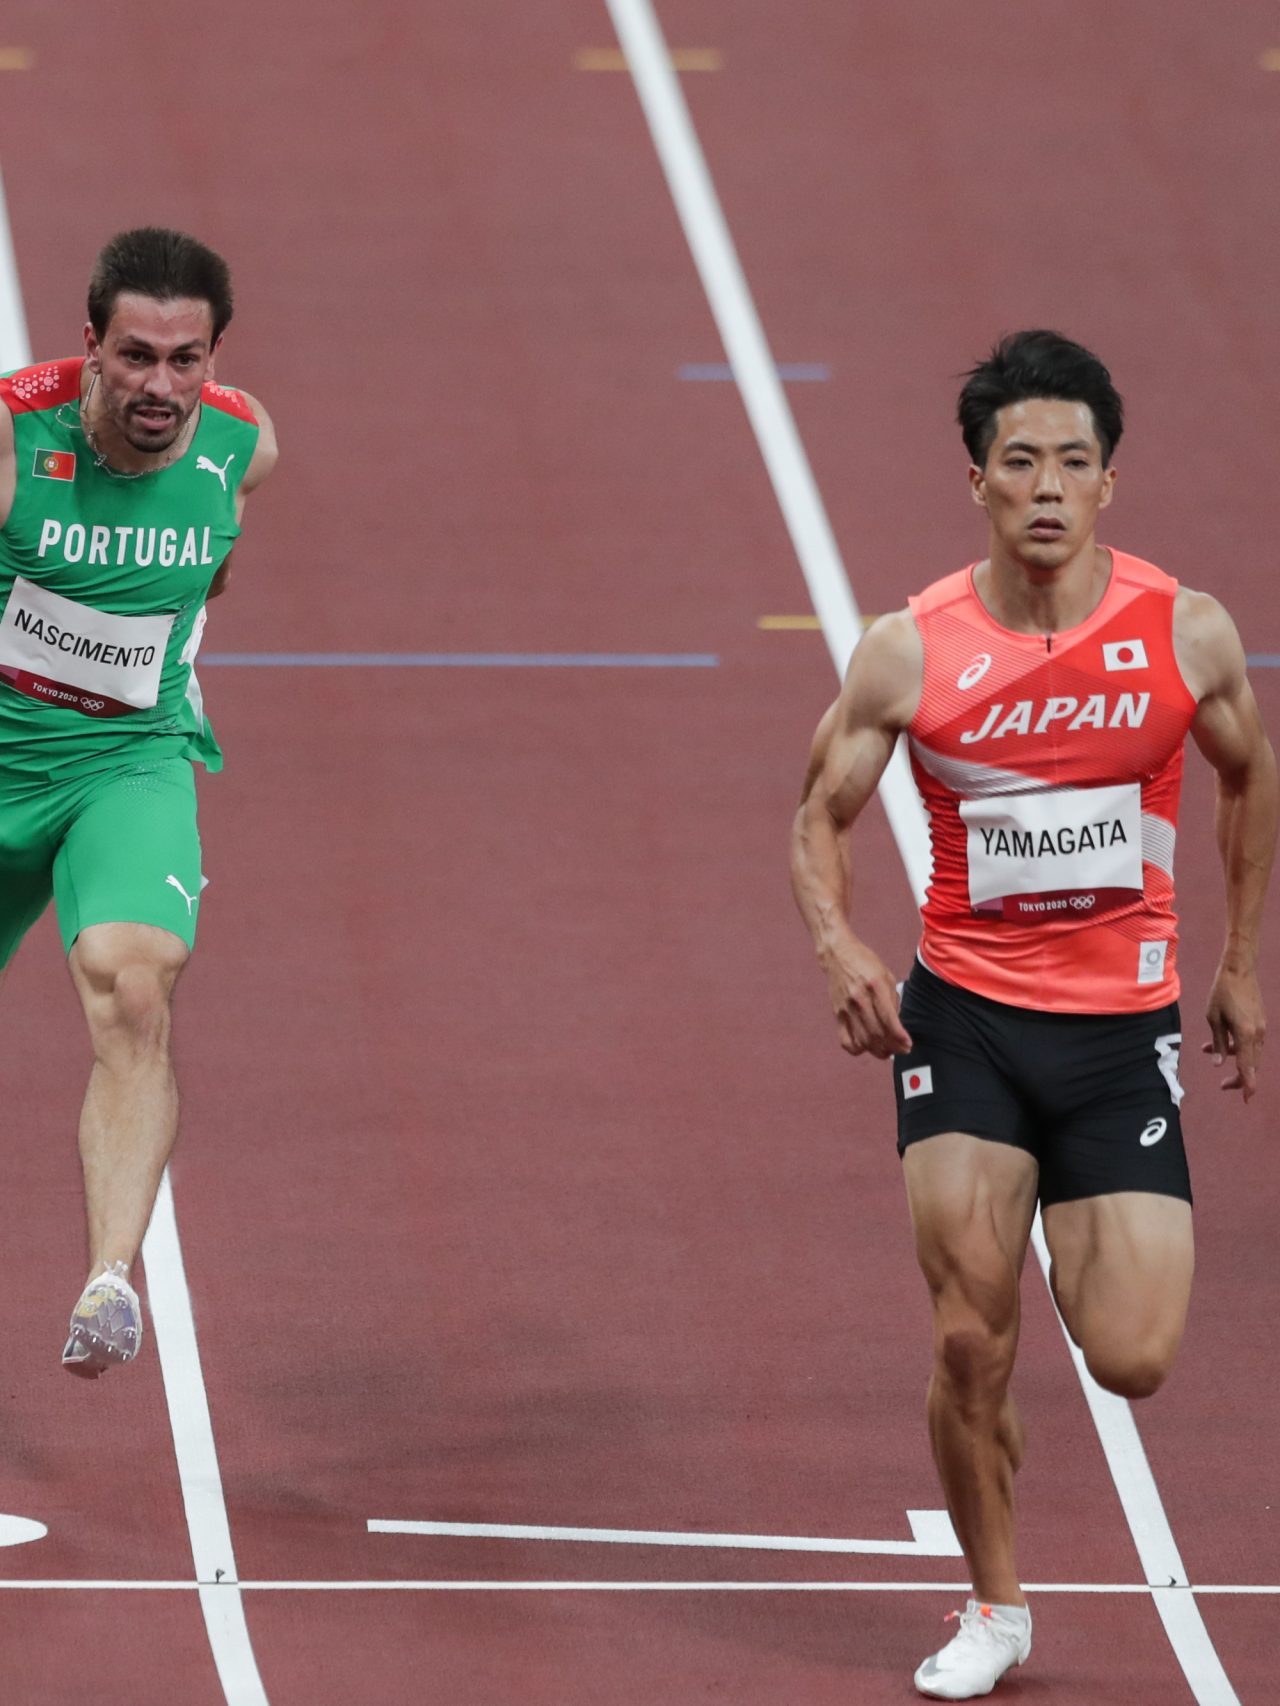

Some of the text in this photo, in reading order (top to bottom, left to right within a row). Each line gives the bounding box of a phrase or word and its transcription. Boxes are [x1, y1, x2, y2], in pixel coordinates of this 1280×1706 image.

[37, 518, 213, 568] PORTUGAL
[13, 608, 156, 668] NASCIMENTO
[32, 682, 78, 703] TOKYO 2020
[959, 692, 1150, 744] JAPAN
[980, 819, 1128, 858] YAMAGATA
[1019, 900, 1068, 912] TOKYO 2020
